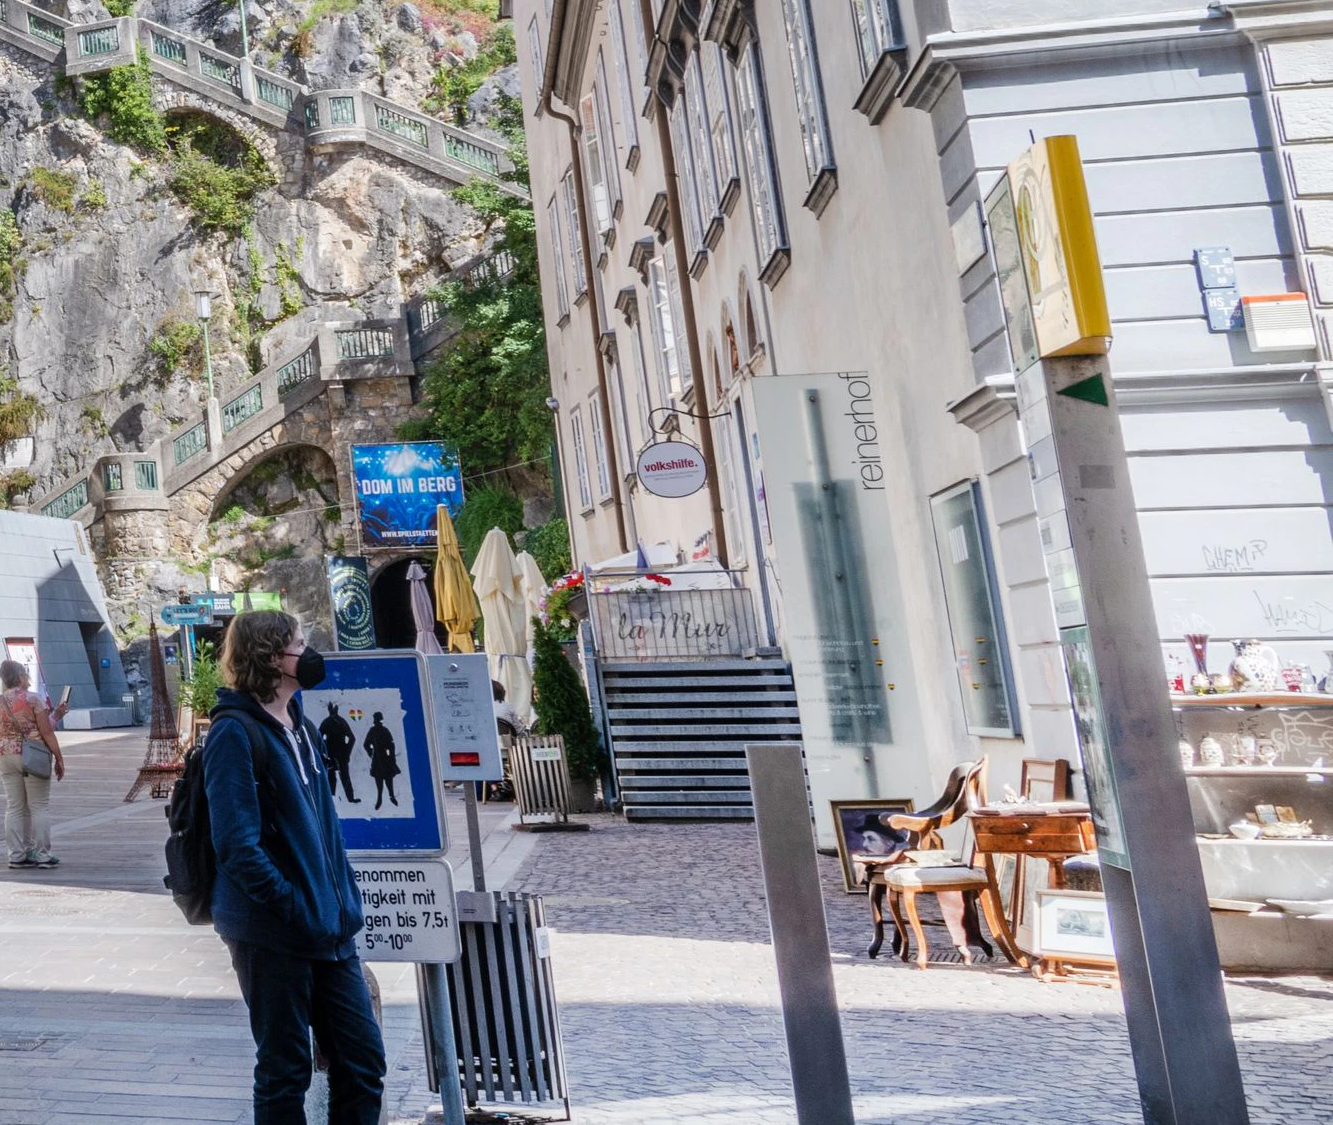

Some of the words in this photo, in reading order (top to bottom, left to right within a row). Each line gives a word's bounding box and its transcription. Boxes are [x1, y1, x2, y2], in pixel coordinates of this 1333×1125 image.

[837, 371, 885, 490] reinerhof
[644, 458, 698, 473] volkshilfe.
[361, 479, 393, 495] DOM
[396, 477, 414, 493] IM
[418, 476, 456, 492] BERG
[618, 613, 648, 639] la
[649, 611, 730, 639] Mur
[413, 889, 436, 905] mit
[397, 912, 417, 928] bis
[422, 912, 449, 928] 7,5t
